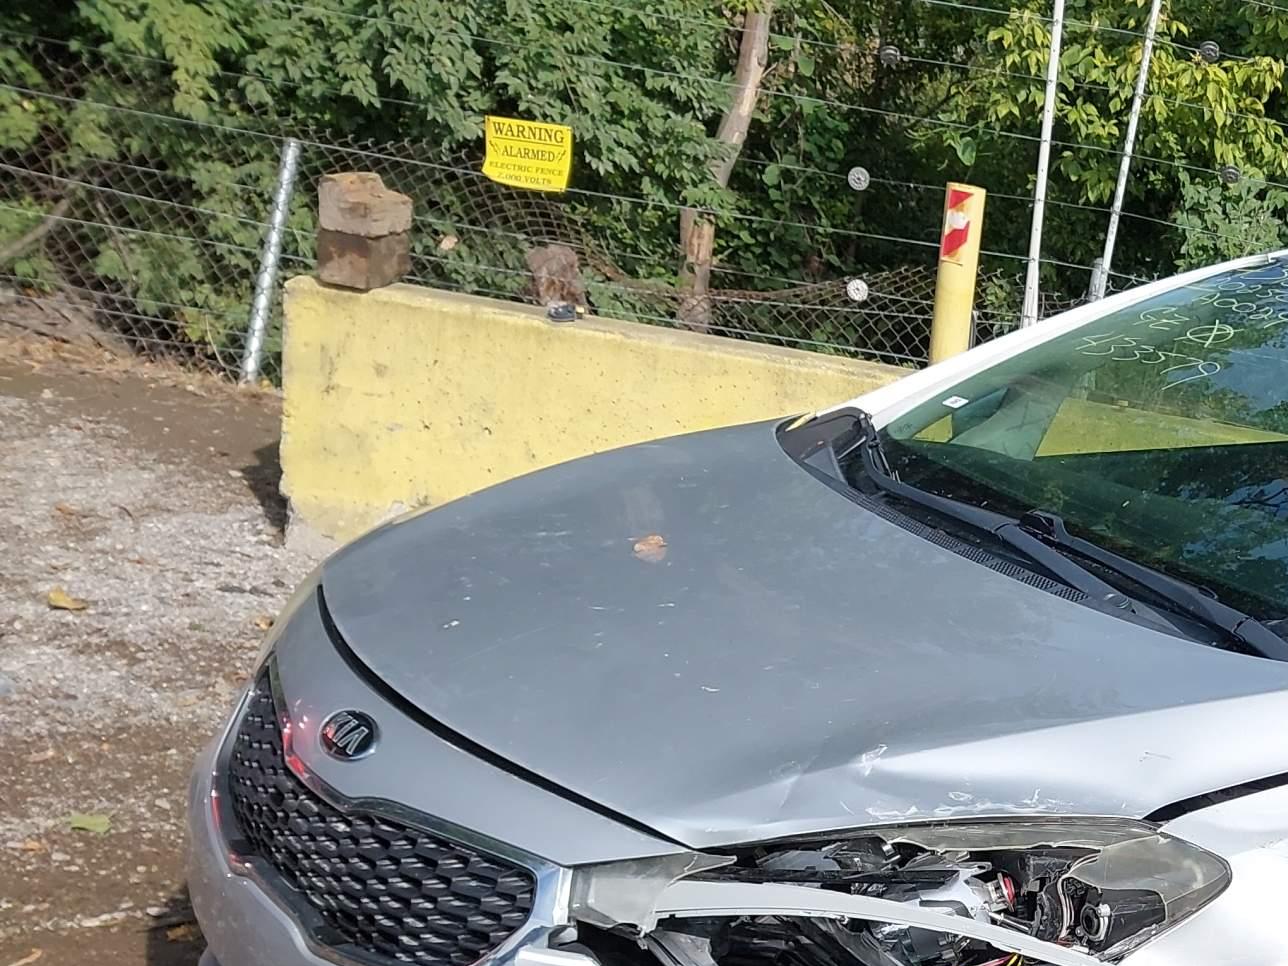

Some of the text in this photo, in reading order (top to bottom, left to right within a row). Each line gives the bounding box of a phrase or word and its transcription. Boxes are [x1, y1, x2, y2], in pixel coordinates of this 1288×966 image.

[492, 121, 564, 144] WARNING
[502, 145, 555, 162] ALARMED
[489, 161, 533, 173] ELECTRIC
[524, 175, 552, 185] VOLTS
